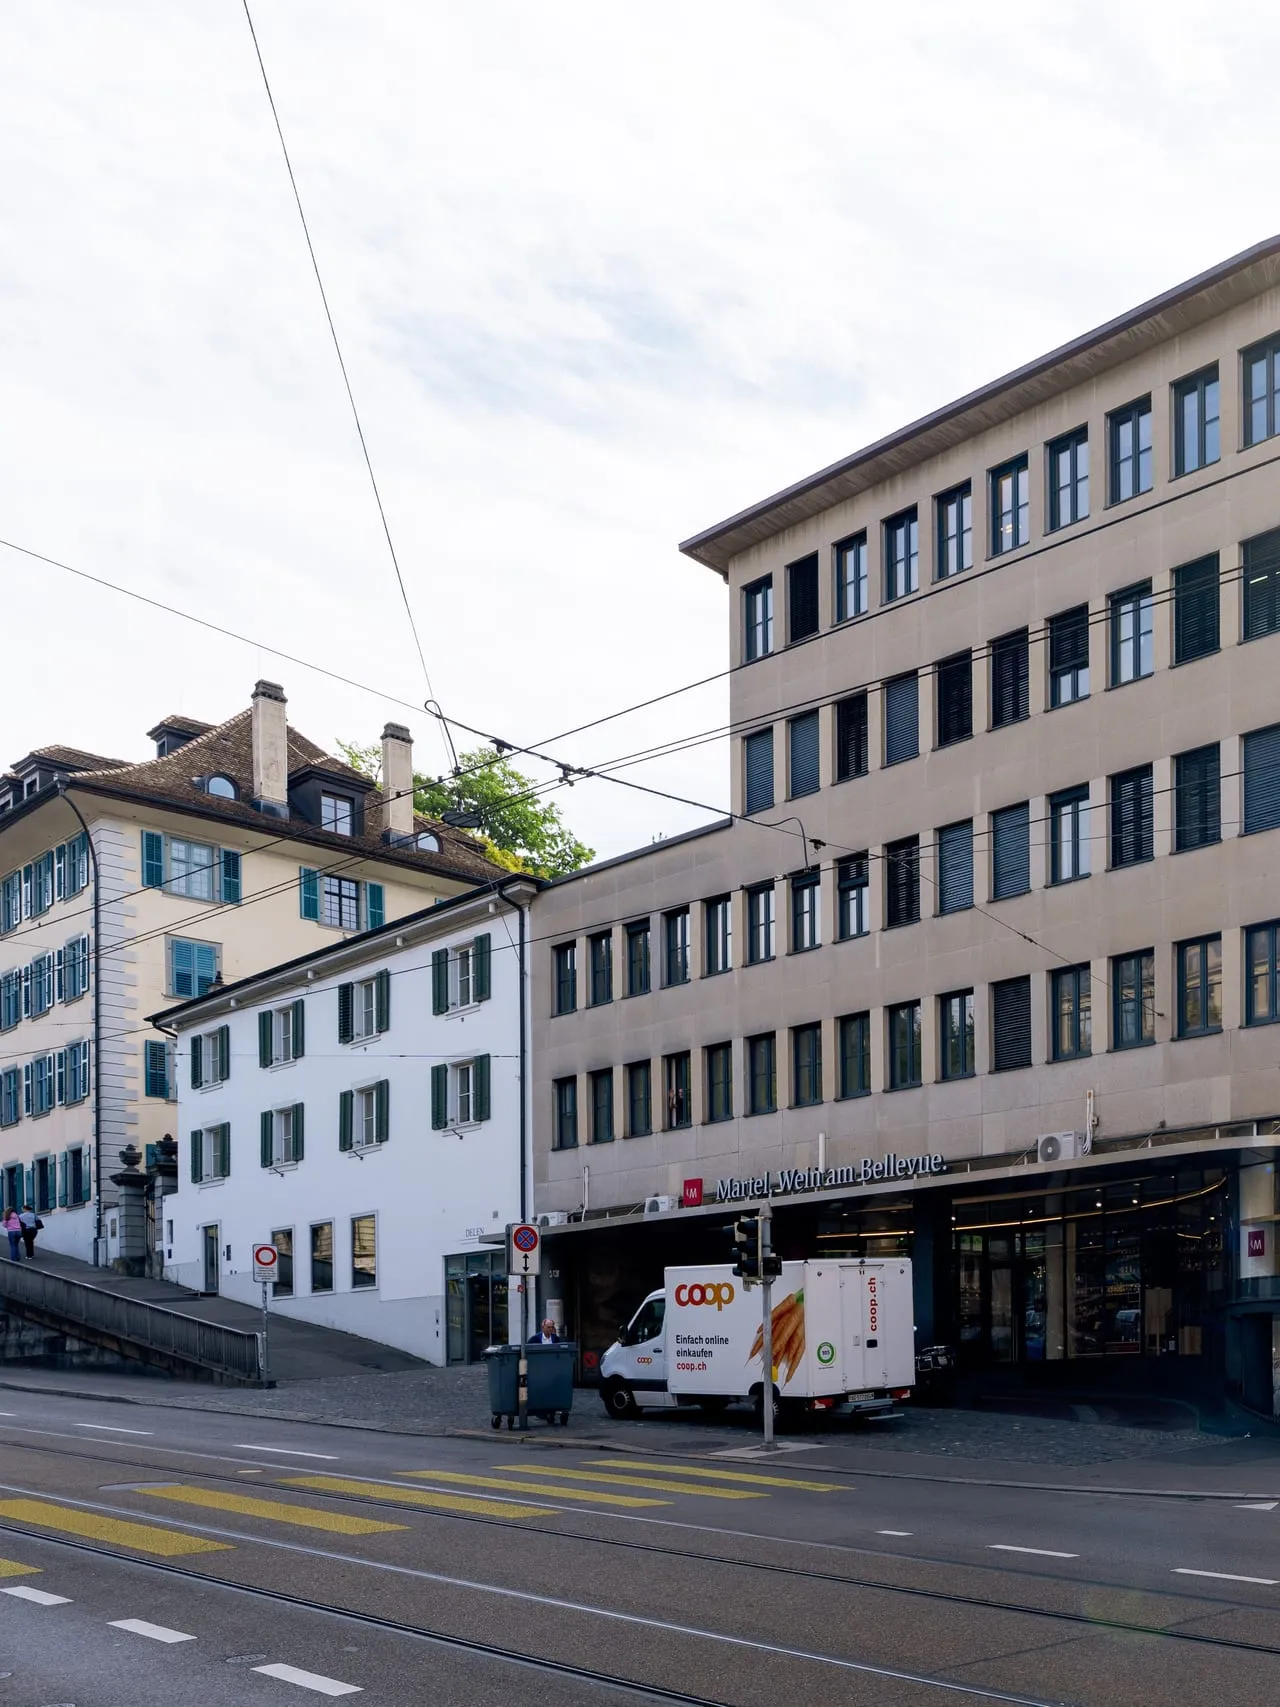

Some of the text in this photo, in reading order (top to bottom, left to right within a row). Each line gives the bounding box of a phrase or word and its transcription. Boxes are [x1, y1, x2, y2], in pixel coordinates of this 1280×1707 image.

[777, 1167, 822, 1193] Wein
[826, 1165, 855, 1186] am
[859, 1153, 948, 1182] Bellevue.
[674, 1282, 735, 1312] coop
[867, 1277, 878, 1332] coop.ch
[675, 1334, 730, 1345] Einfach online
[676, 1348, 713, 1358] einkaufen
[637, 1357, 653, 1365] coop
[676, 1361, 707, 1372] coop.ch
